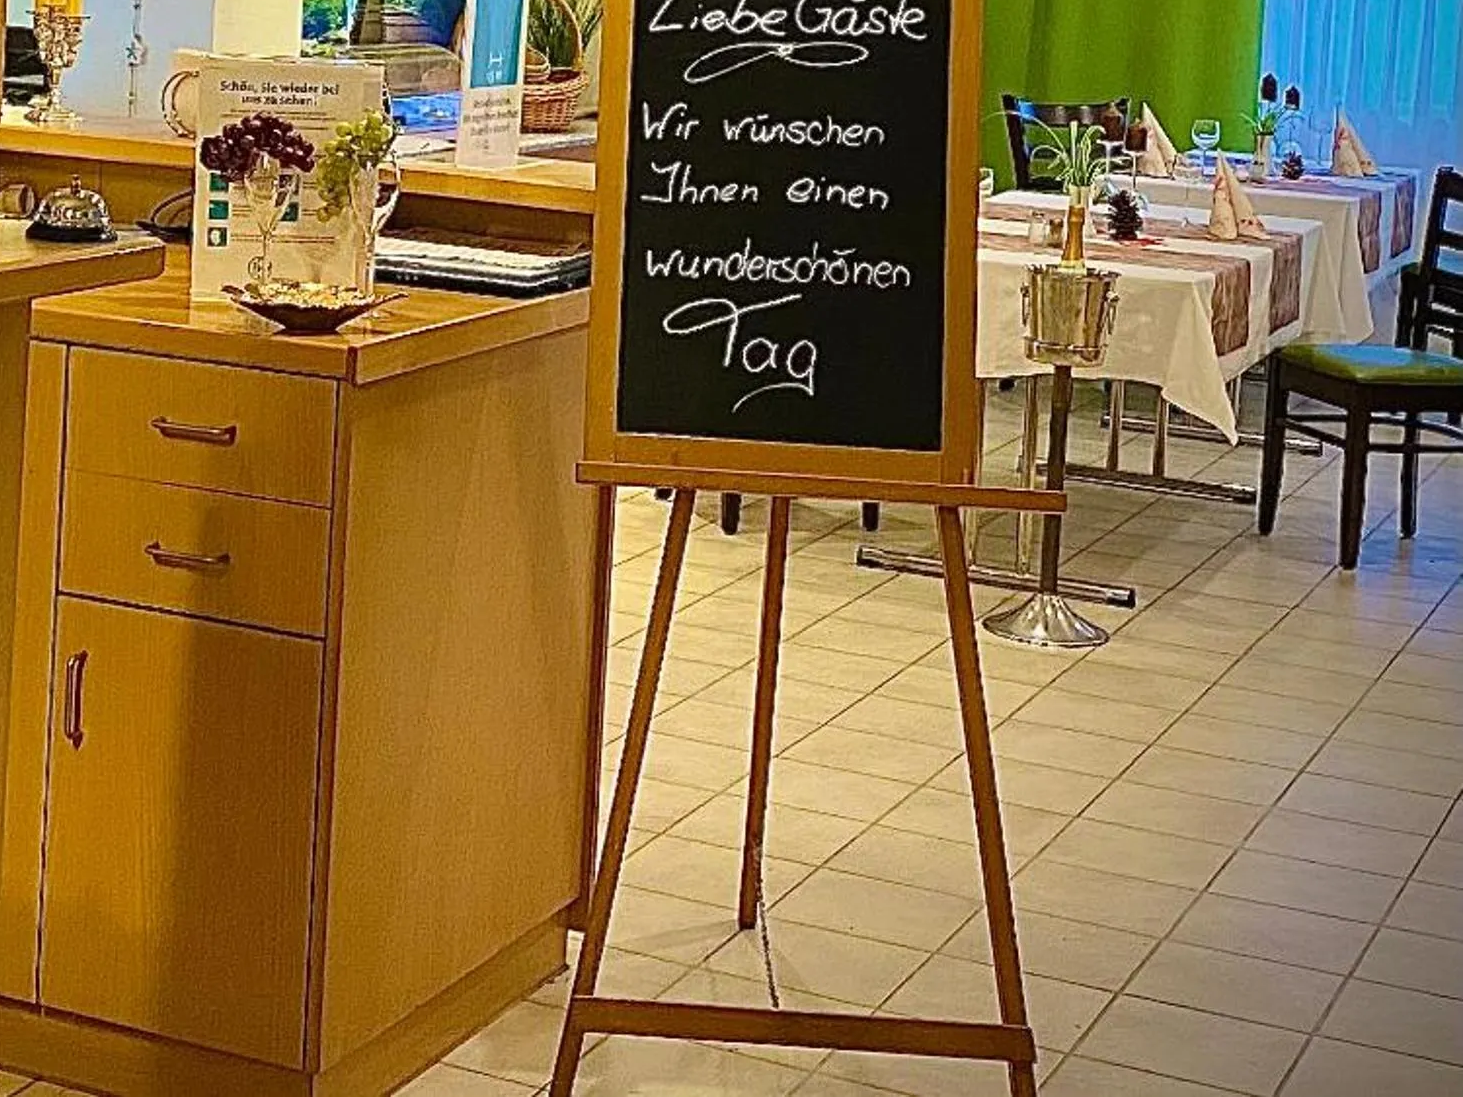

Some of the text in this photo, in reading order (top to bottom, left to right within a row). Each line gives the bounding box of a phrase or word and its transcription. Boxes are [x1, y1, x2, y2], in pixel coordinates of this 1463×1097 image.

[278, 82, 320, 94] wieder
[321, 82, 340, 96] bei
[641, 100, 886, 147] Wir wünschen
[639, 160, 889, 210] Ihnen einen
[645, 236, 912, 289] wunderschönen
[662, 293, 818, 413] Tag
